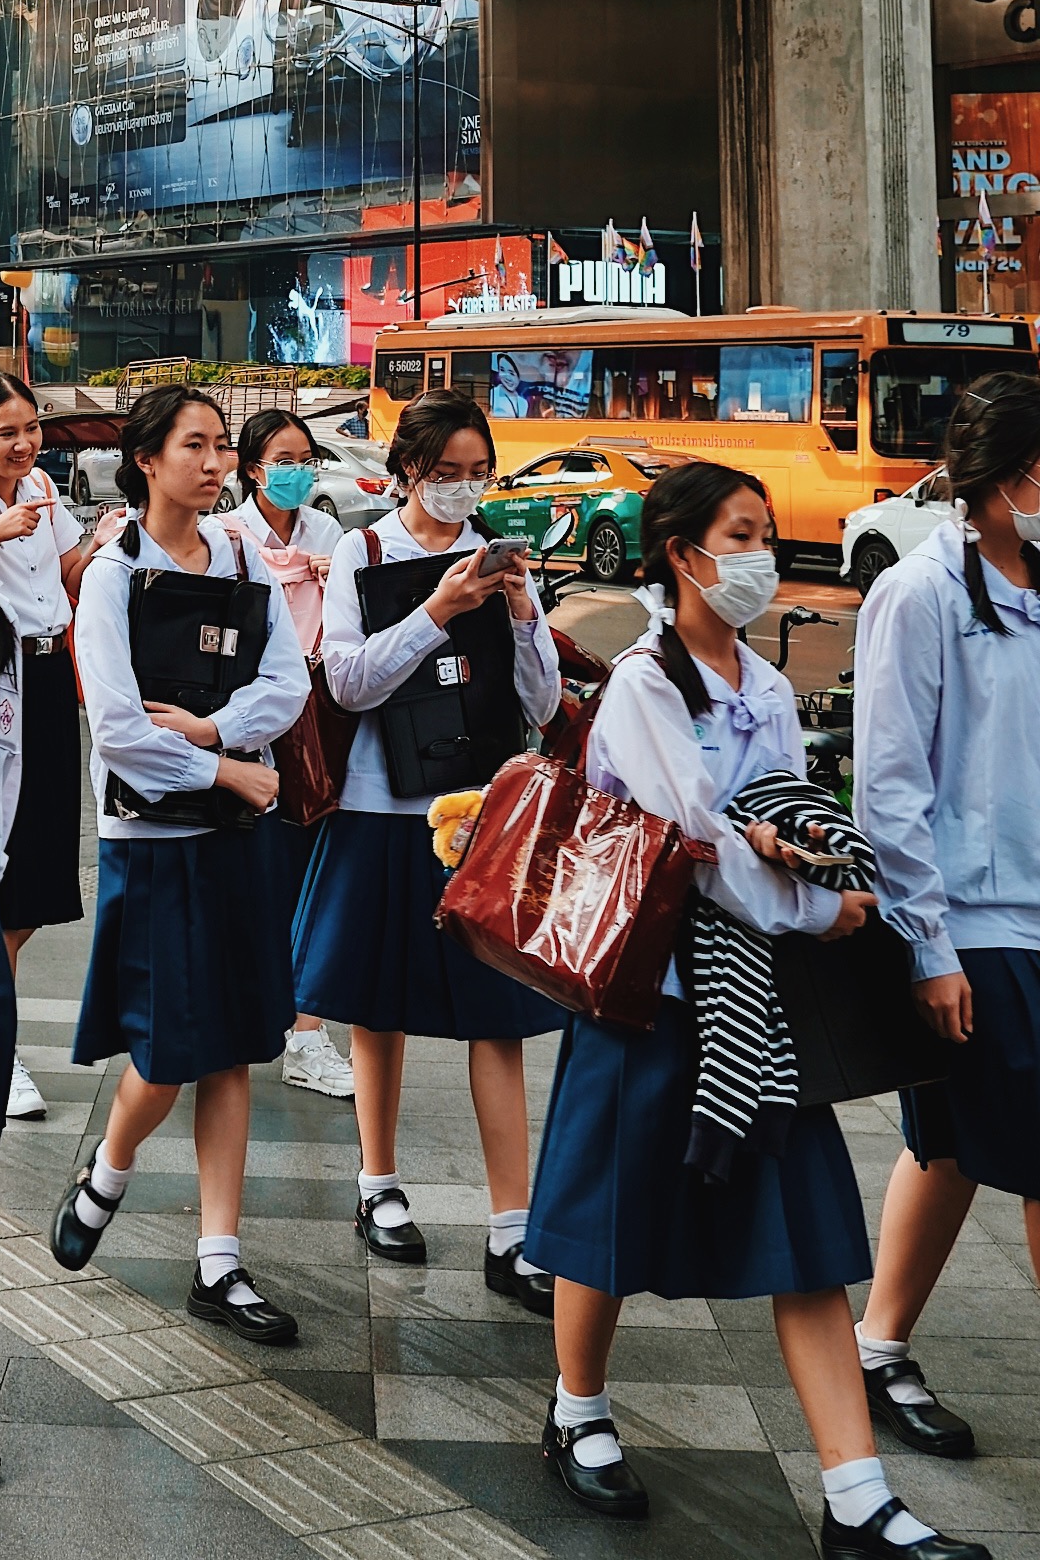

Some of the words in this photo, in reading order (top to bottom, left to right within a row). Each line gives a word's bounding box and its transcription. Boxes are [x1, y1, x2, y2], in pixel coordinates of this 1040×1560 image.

[559, 260, 666, 304] PUMA
[943, 324, 970, 338] 79
[389, 360, 421, 372] 6-56022
